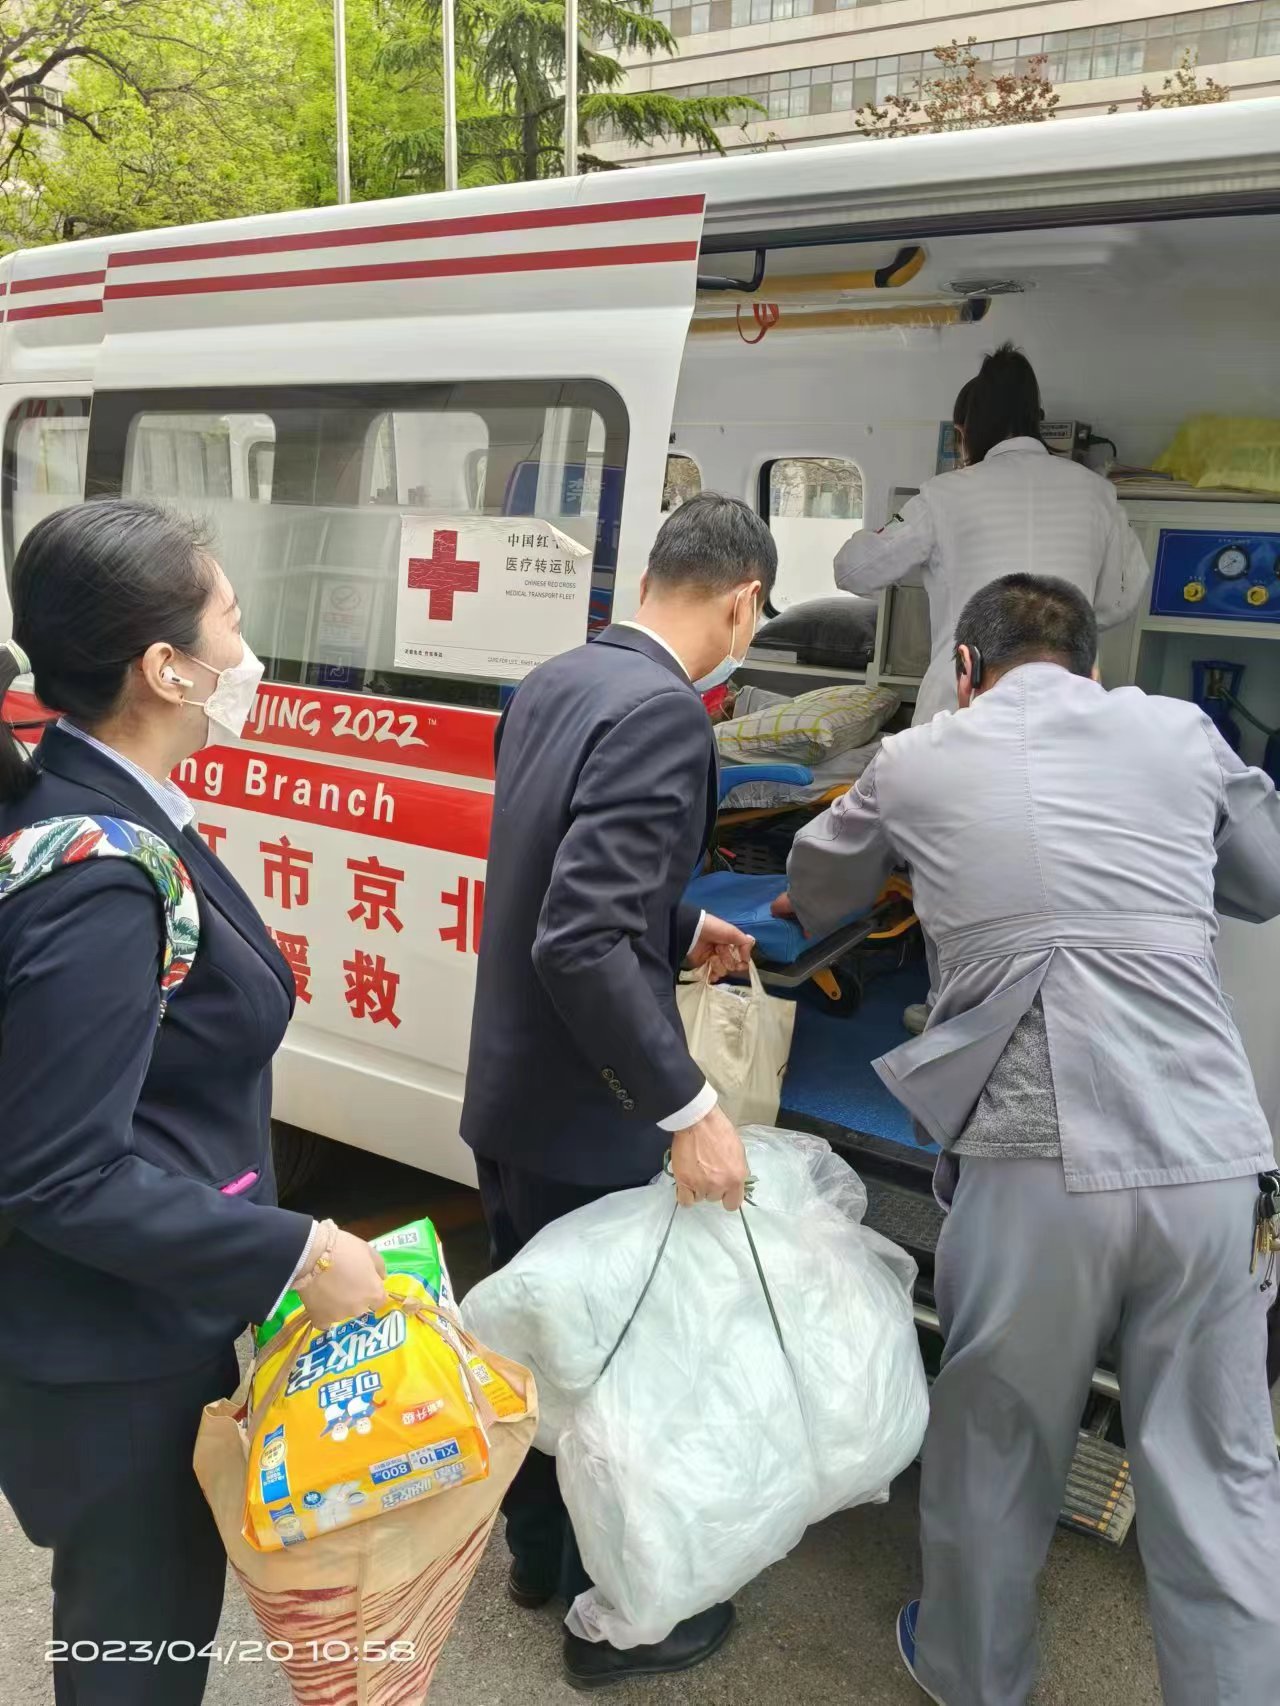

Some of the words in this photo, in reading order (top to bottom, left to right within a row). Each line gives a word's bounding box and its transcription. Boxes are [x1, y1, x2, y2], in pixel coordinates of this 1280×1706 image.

[505, 557, 577, 575] 医疗转运队
[505, 589, 527, 597] MEDICAL
[247, 693, 322, 737] IJING
[331, 704, 429, 748] 2022
[179, 756, 224, 797] ng
[244, 757, 396, 823] Branch
[285, 1309, 406, 1397] 吸收宝
[419, 1453, 435, 1465] 10
[434, 1444, 456, 1458] XL
